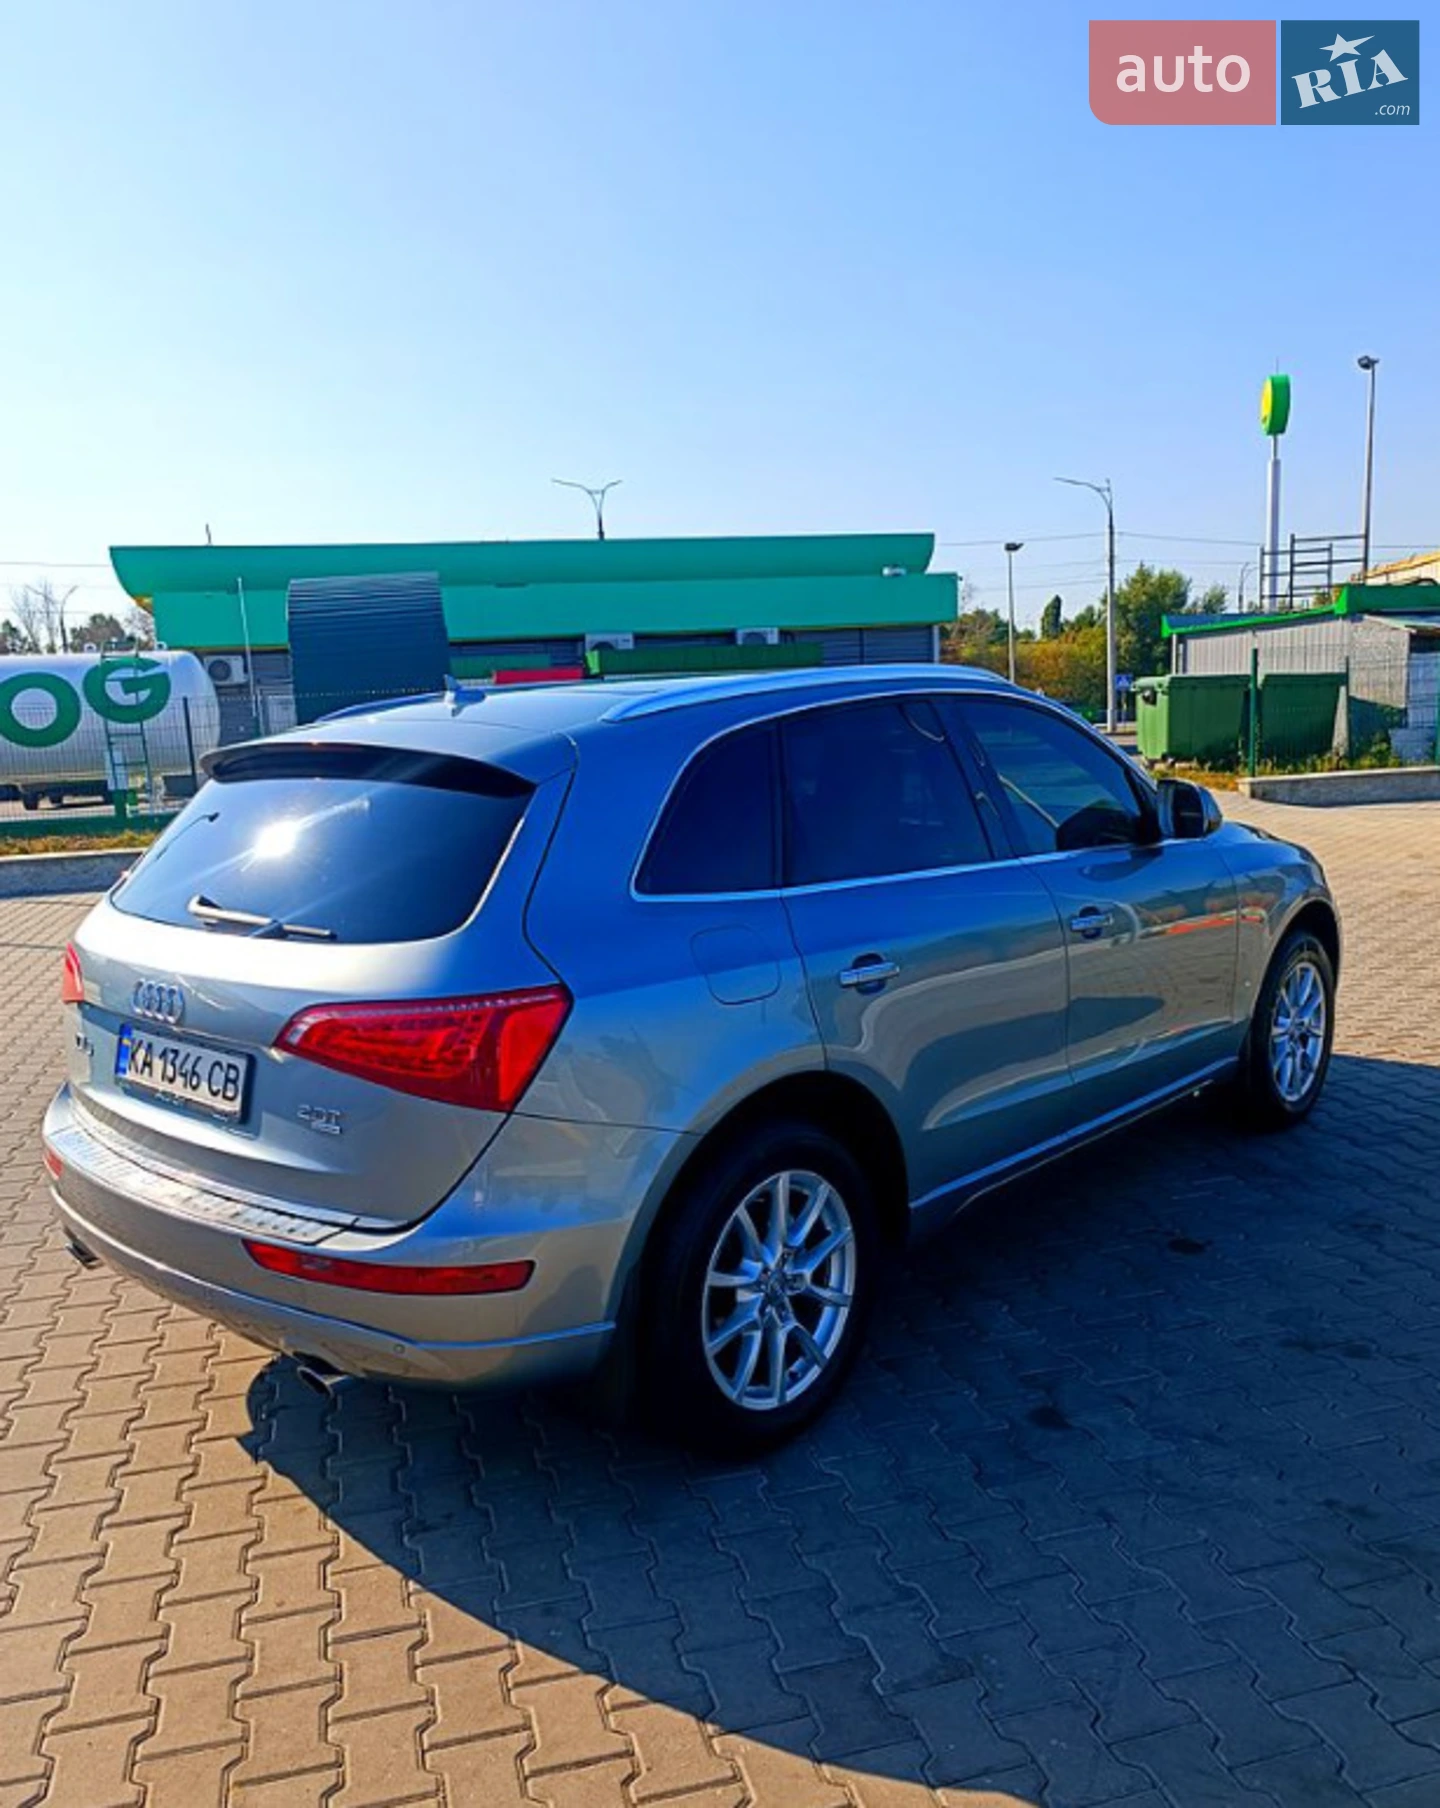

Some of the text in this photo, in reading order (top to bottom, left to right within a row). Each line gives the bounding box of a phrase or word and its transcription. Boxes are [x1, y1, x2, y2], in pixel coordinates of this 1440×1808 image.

[129, 1038, 153, 1078] KA
[159, 1047, 202, 1091] 1346
[208, 1060, 240, 1102] CB
